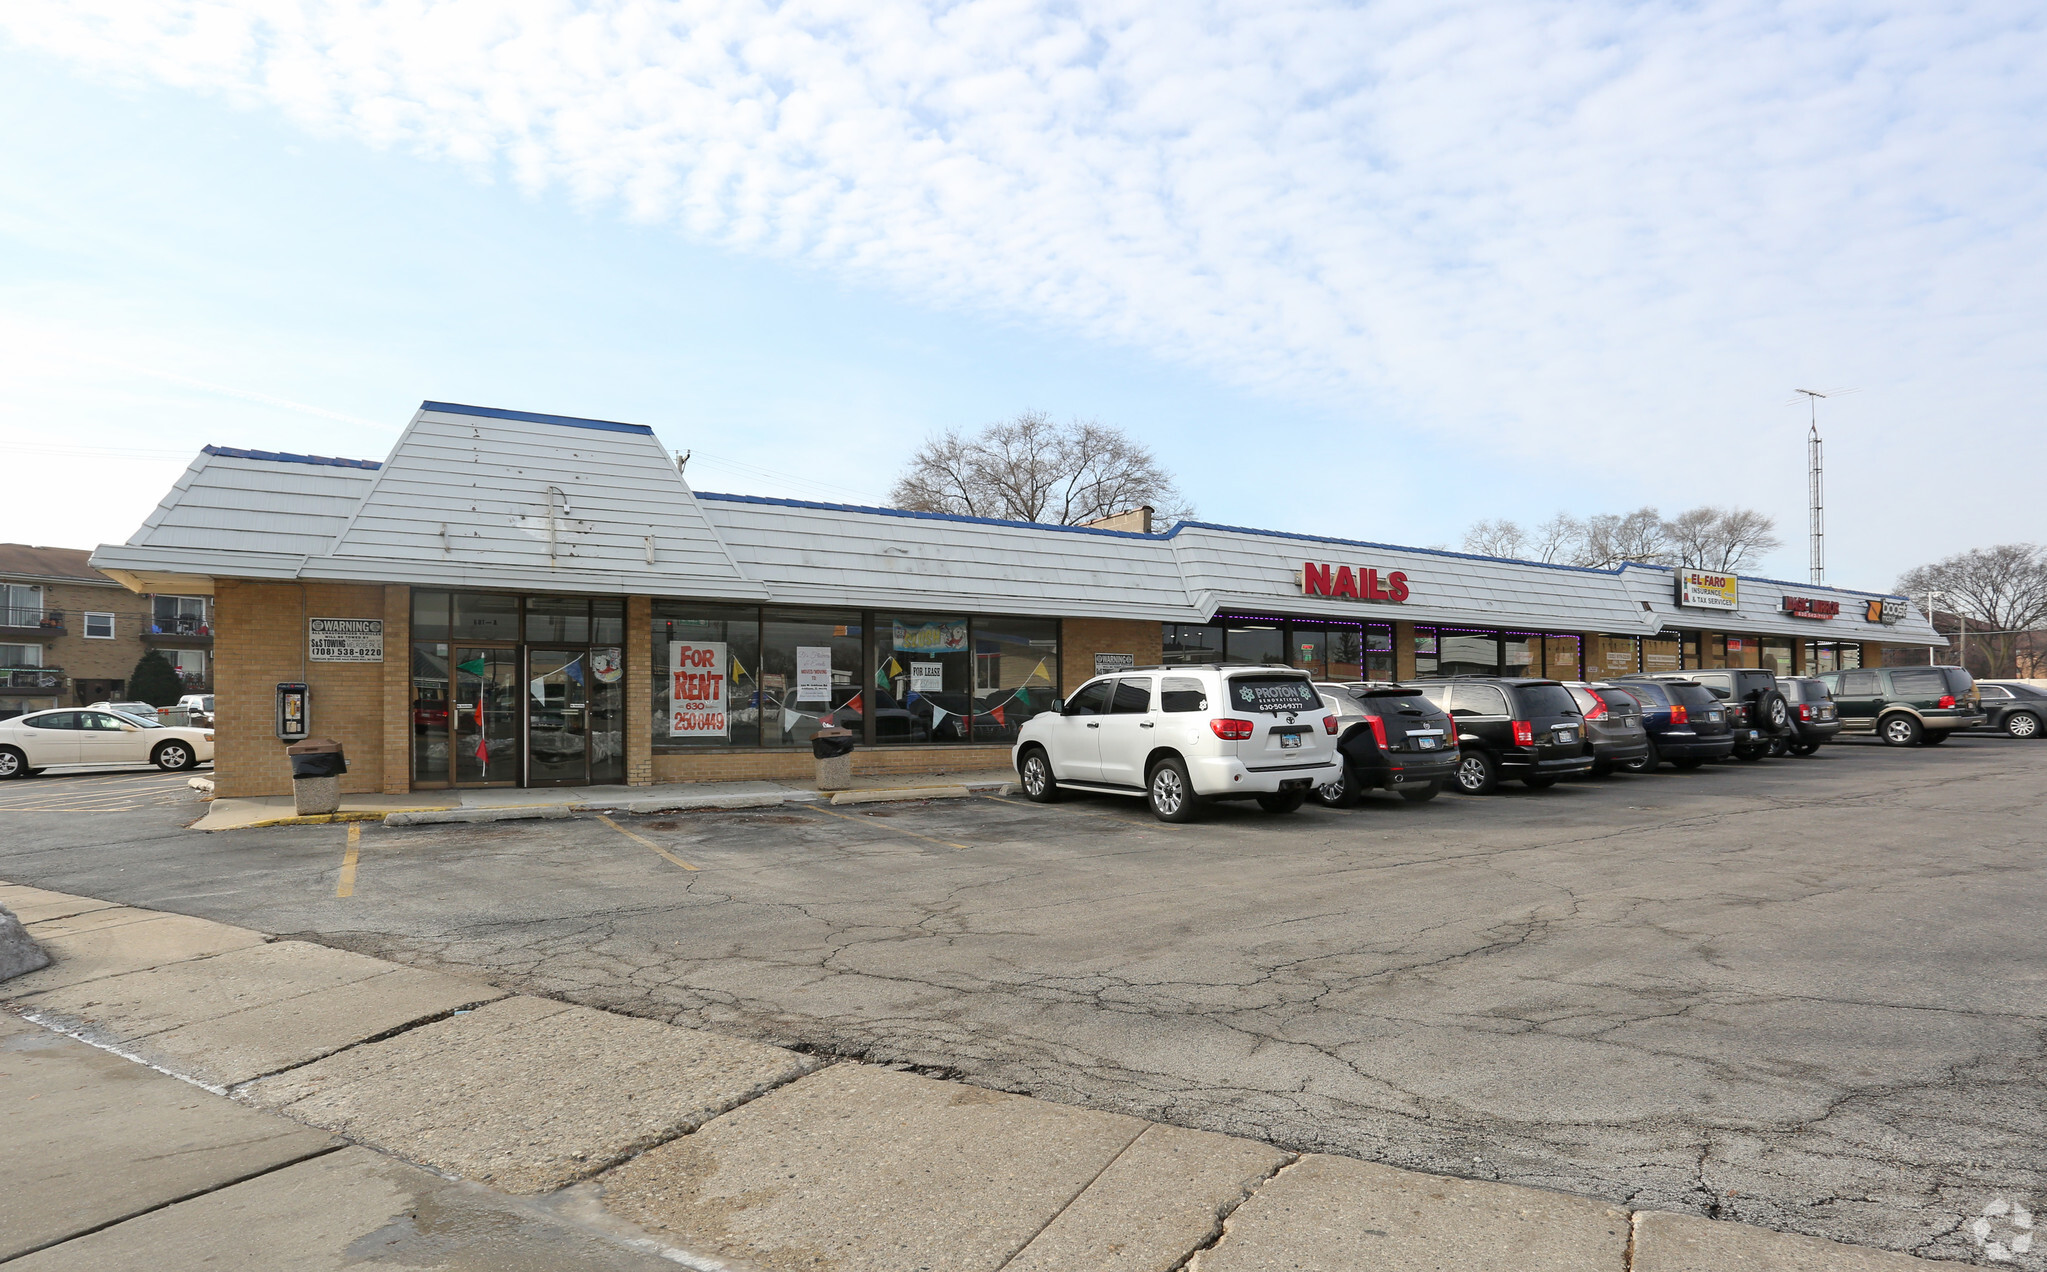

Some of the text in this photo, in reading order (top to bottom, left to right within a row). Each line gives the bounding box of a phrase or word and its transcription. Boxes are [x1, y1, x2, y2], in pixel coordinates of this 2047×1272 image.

[1302, 562, 1409, 602] NAILS
[1692, 574, 1726, 588] EL FARO
[1692, 587, 1722, 596] INSURANCE
[1708, 598, 1732, 606] SERVICES
[1882, 599, 1907, 617] boost
[324, 620, 370, 632] WARNING
[311, 639, 346, 648] S&S TOWING
[903, 628, 940, 648] SLUSH
[312, 648, 382, 656] (708) 538-0220
[913, 667, 941, 677] FOR LEASE
[673, 670, 724, 701] RENT
[1255, 686, 1299, 699] PROTON
[686, 702, 705, 710] 630
